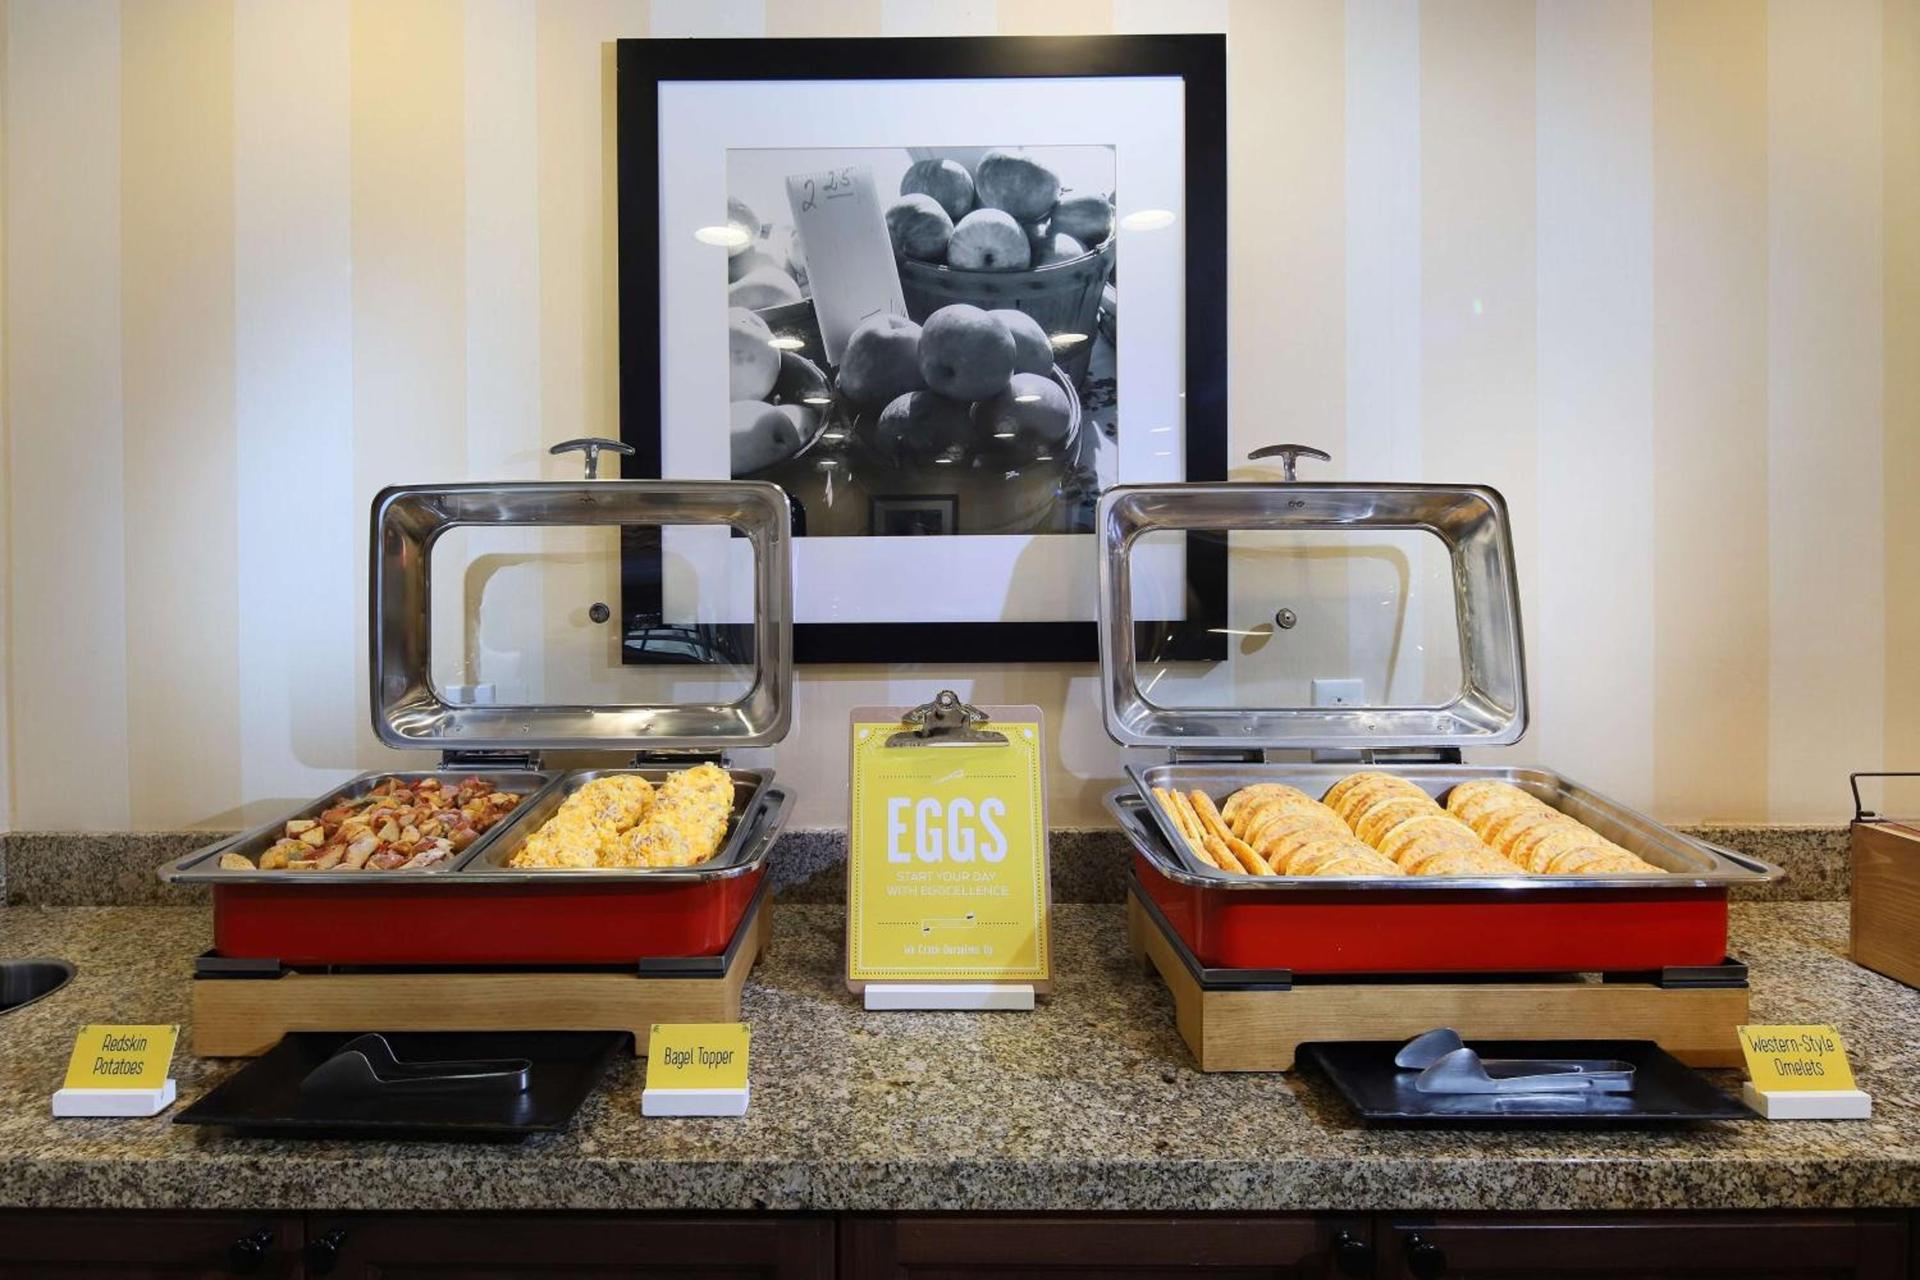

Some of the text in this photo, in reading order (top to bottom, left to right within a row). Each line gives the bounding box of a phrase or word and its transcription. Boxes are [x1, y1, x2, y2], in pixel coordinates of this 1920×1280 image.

[802, 179, 818, 212] 2
[887, 797, 1008, 864] EGGS
[896, 871, 997, 882] START YOUR DAY
[886, 885, 918, 897] WITH
[101, 1033, 148, 1053] Redskin
[1748, 1033, 1836, 1058] Western-Style
[92, 1056, 145, 1076] Potatoes
[664, 1046, 735, 1070] Bagel Topper
[1774, 1057, 1826, 1077] Omelets
